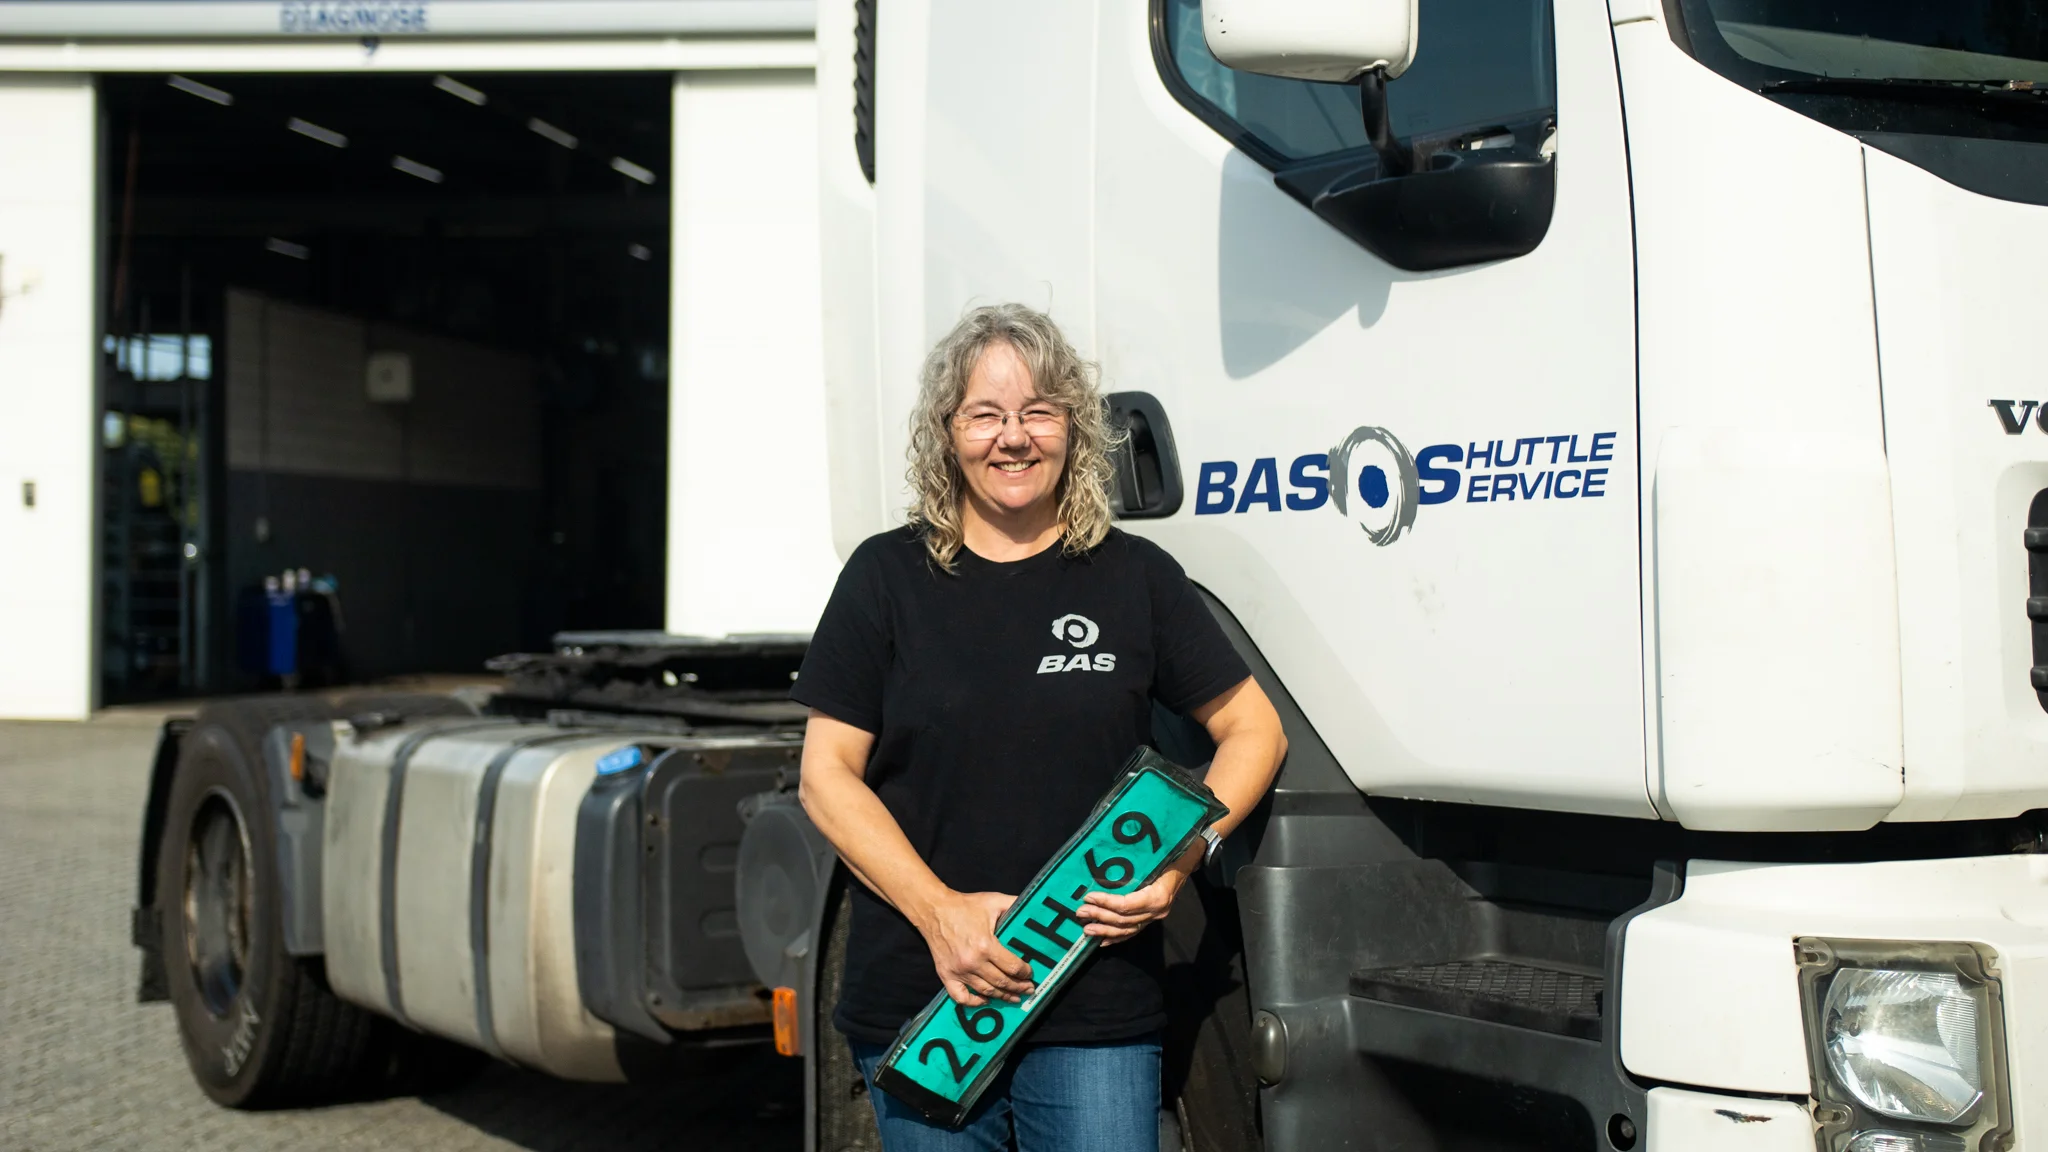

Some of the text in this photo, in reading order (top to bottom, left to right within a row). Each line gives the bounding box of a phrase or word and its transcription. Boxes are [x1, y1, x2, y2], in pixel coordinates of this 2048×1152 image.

[281, 2, 428, 32] DIAGNOSE
[1195, 453, 1330, 516] BAS
[1036, 653, 1116, 674] BAS
